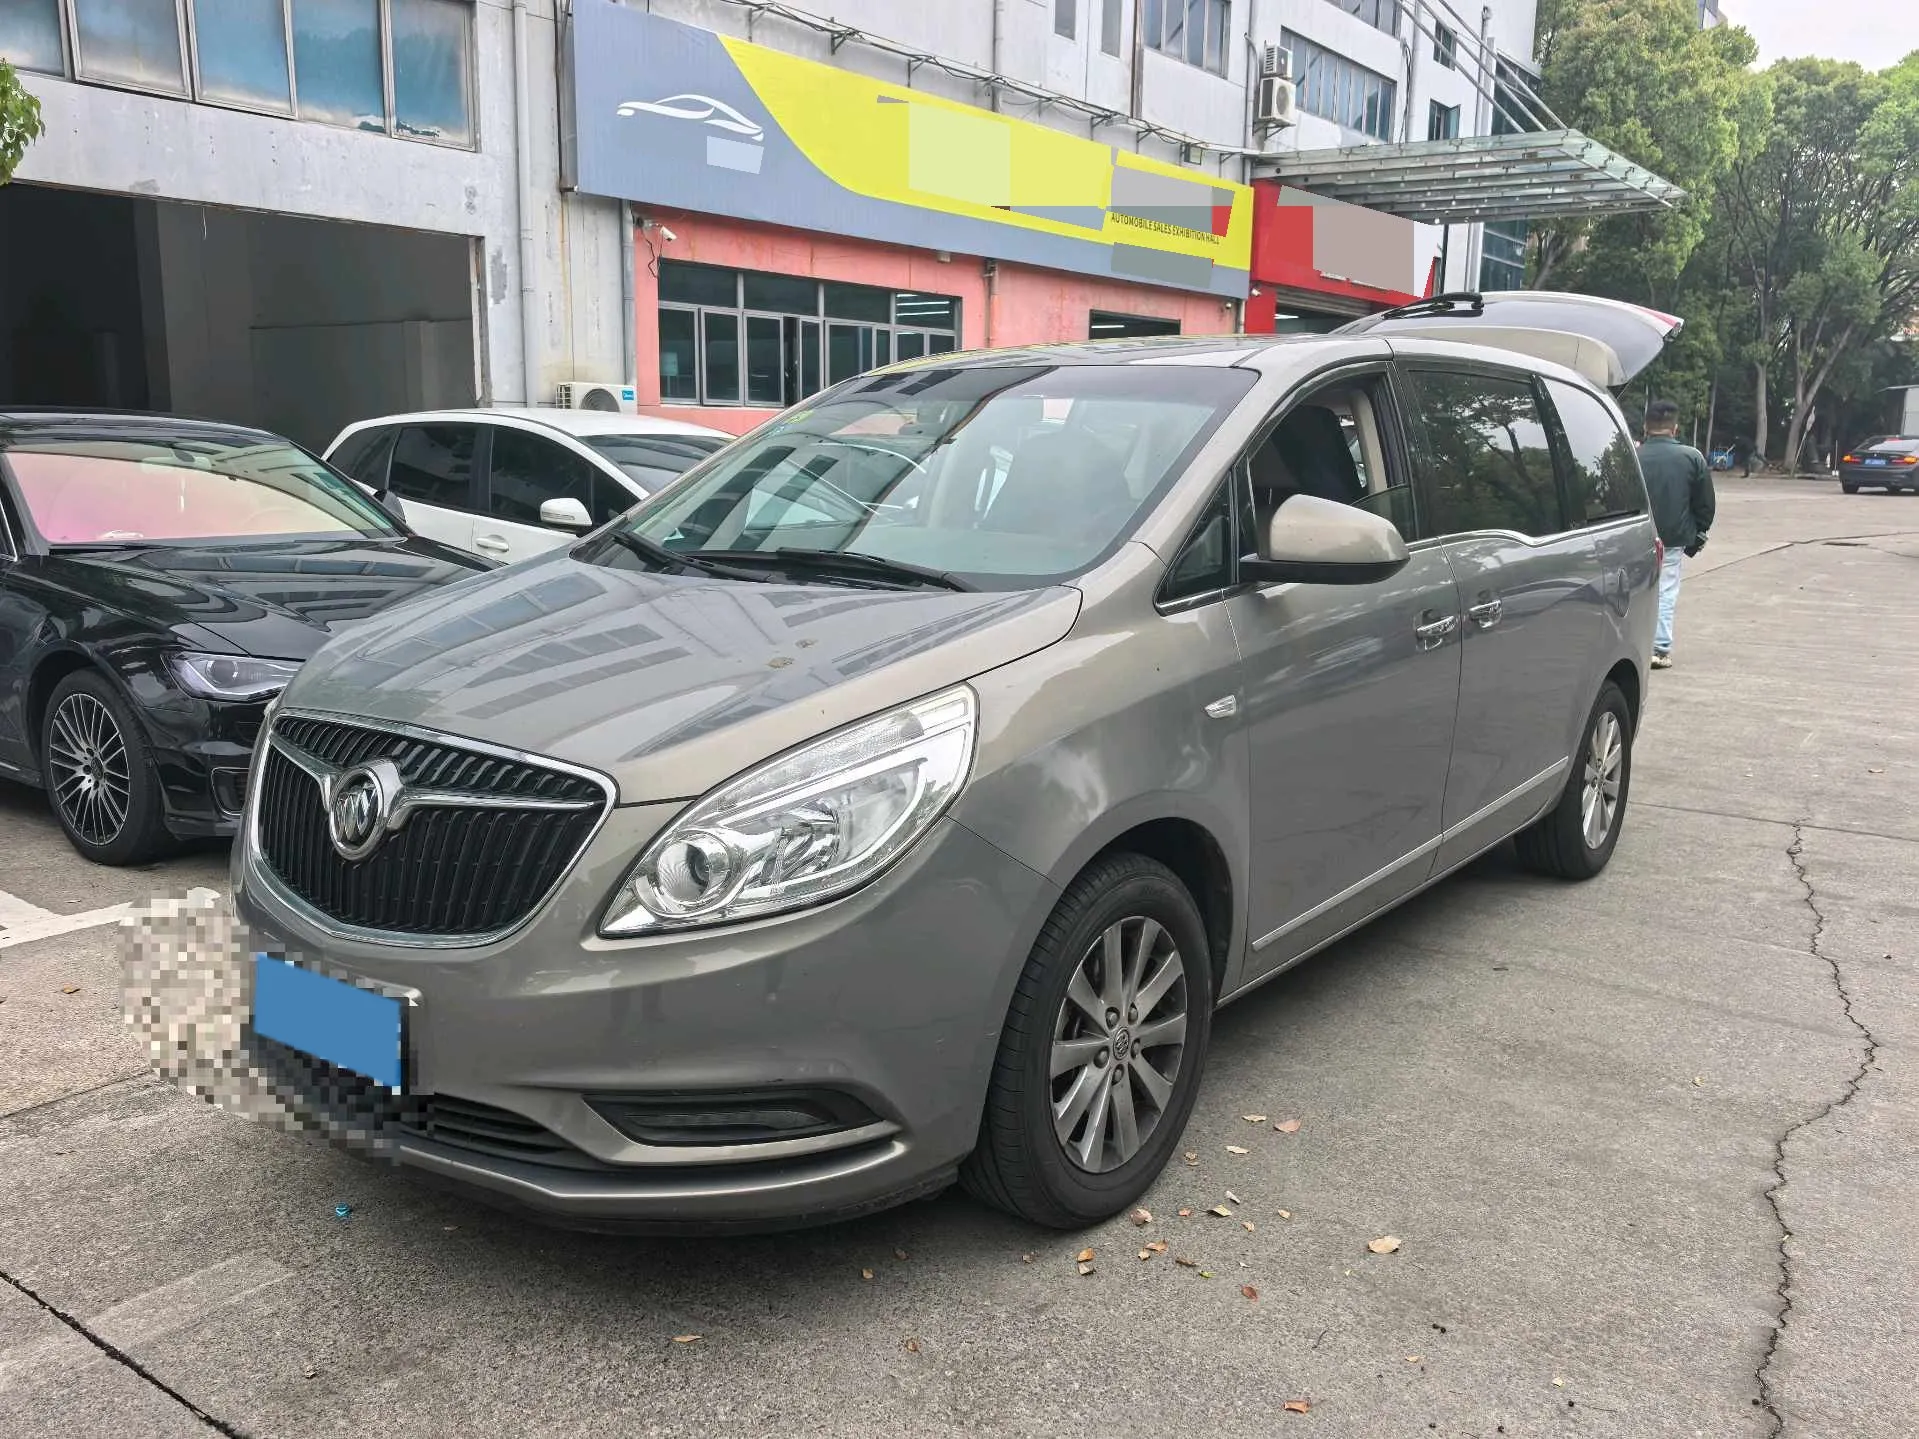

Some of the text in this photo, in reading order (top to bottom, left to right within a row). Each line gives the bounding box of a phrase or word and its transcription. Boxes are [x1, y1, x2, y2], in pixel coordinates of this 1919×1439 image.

[1111, 213, 1220, 245] AUTOMOBILE SALES EXHIBITION HALL
